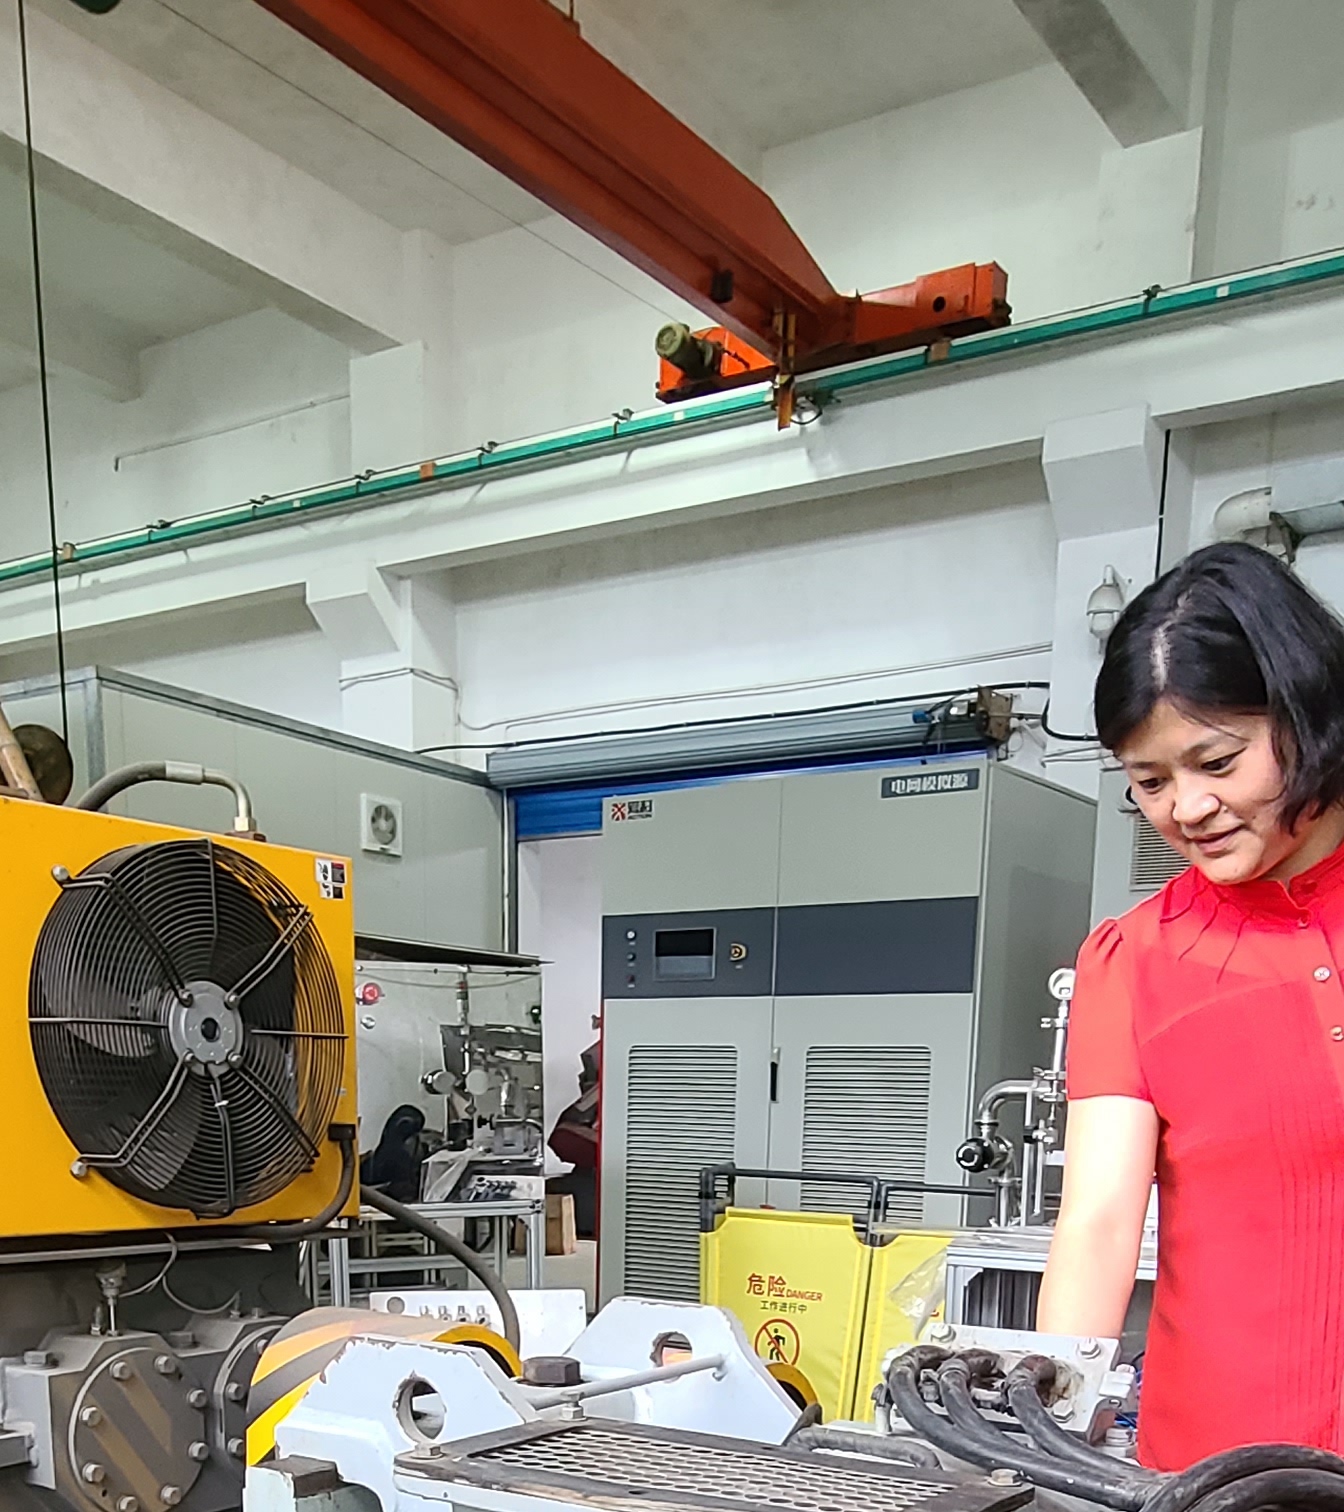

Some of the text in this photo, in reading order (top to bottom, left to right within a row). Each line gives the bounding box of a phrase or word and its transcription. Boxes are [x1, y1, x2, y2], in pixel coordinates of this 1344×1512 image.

[746, 1272, 823, 1301] 危险 DANGER
[760, 1300, 807, 1314] 工作进行中
